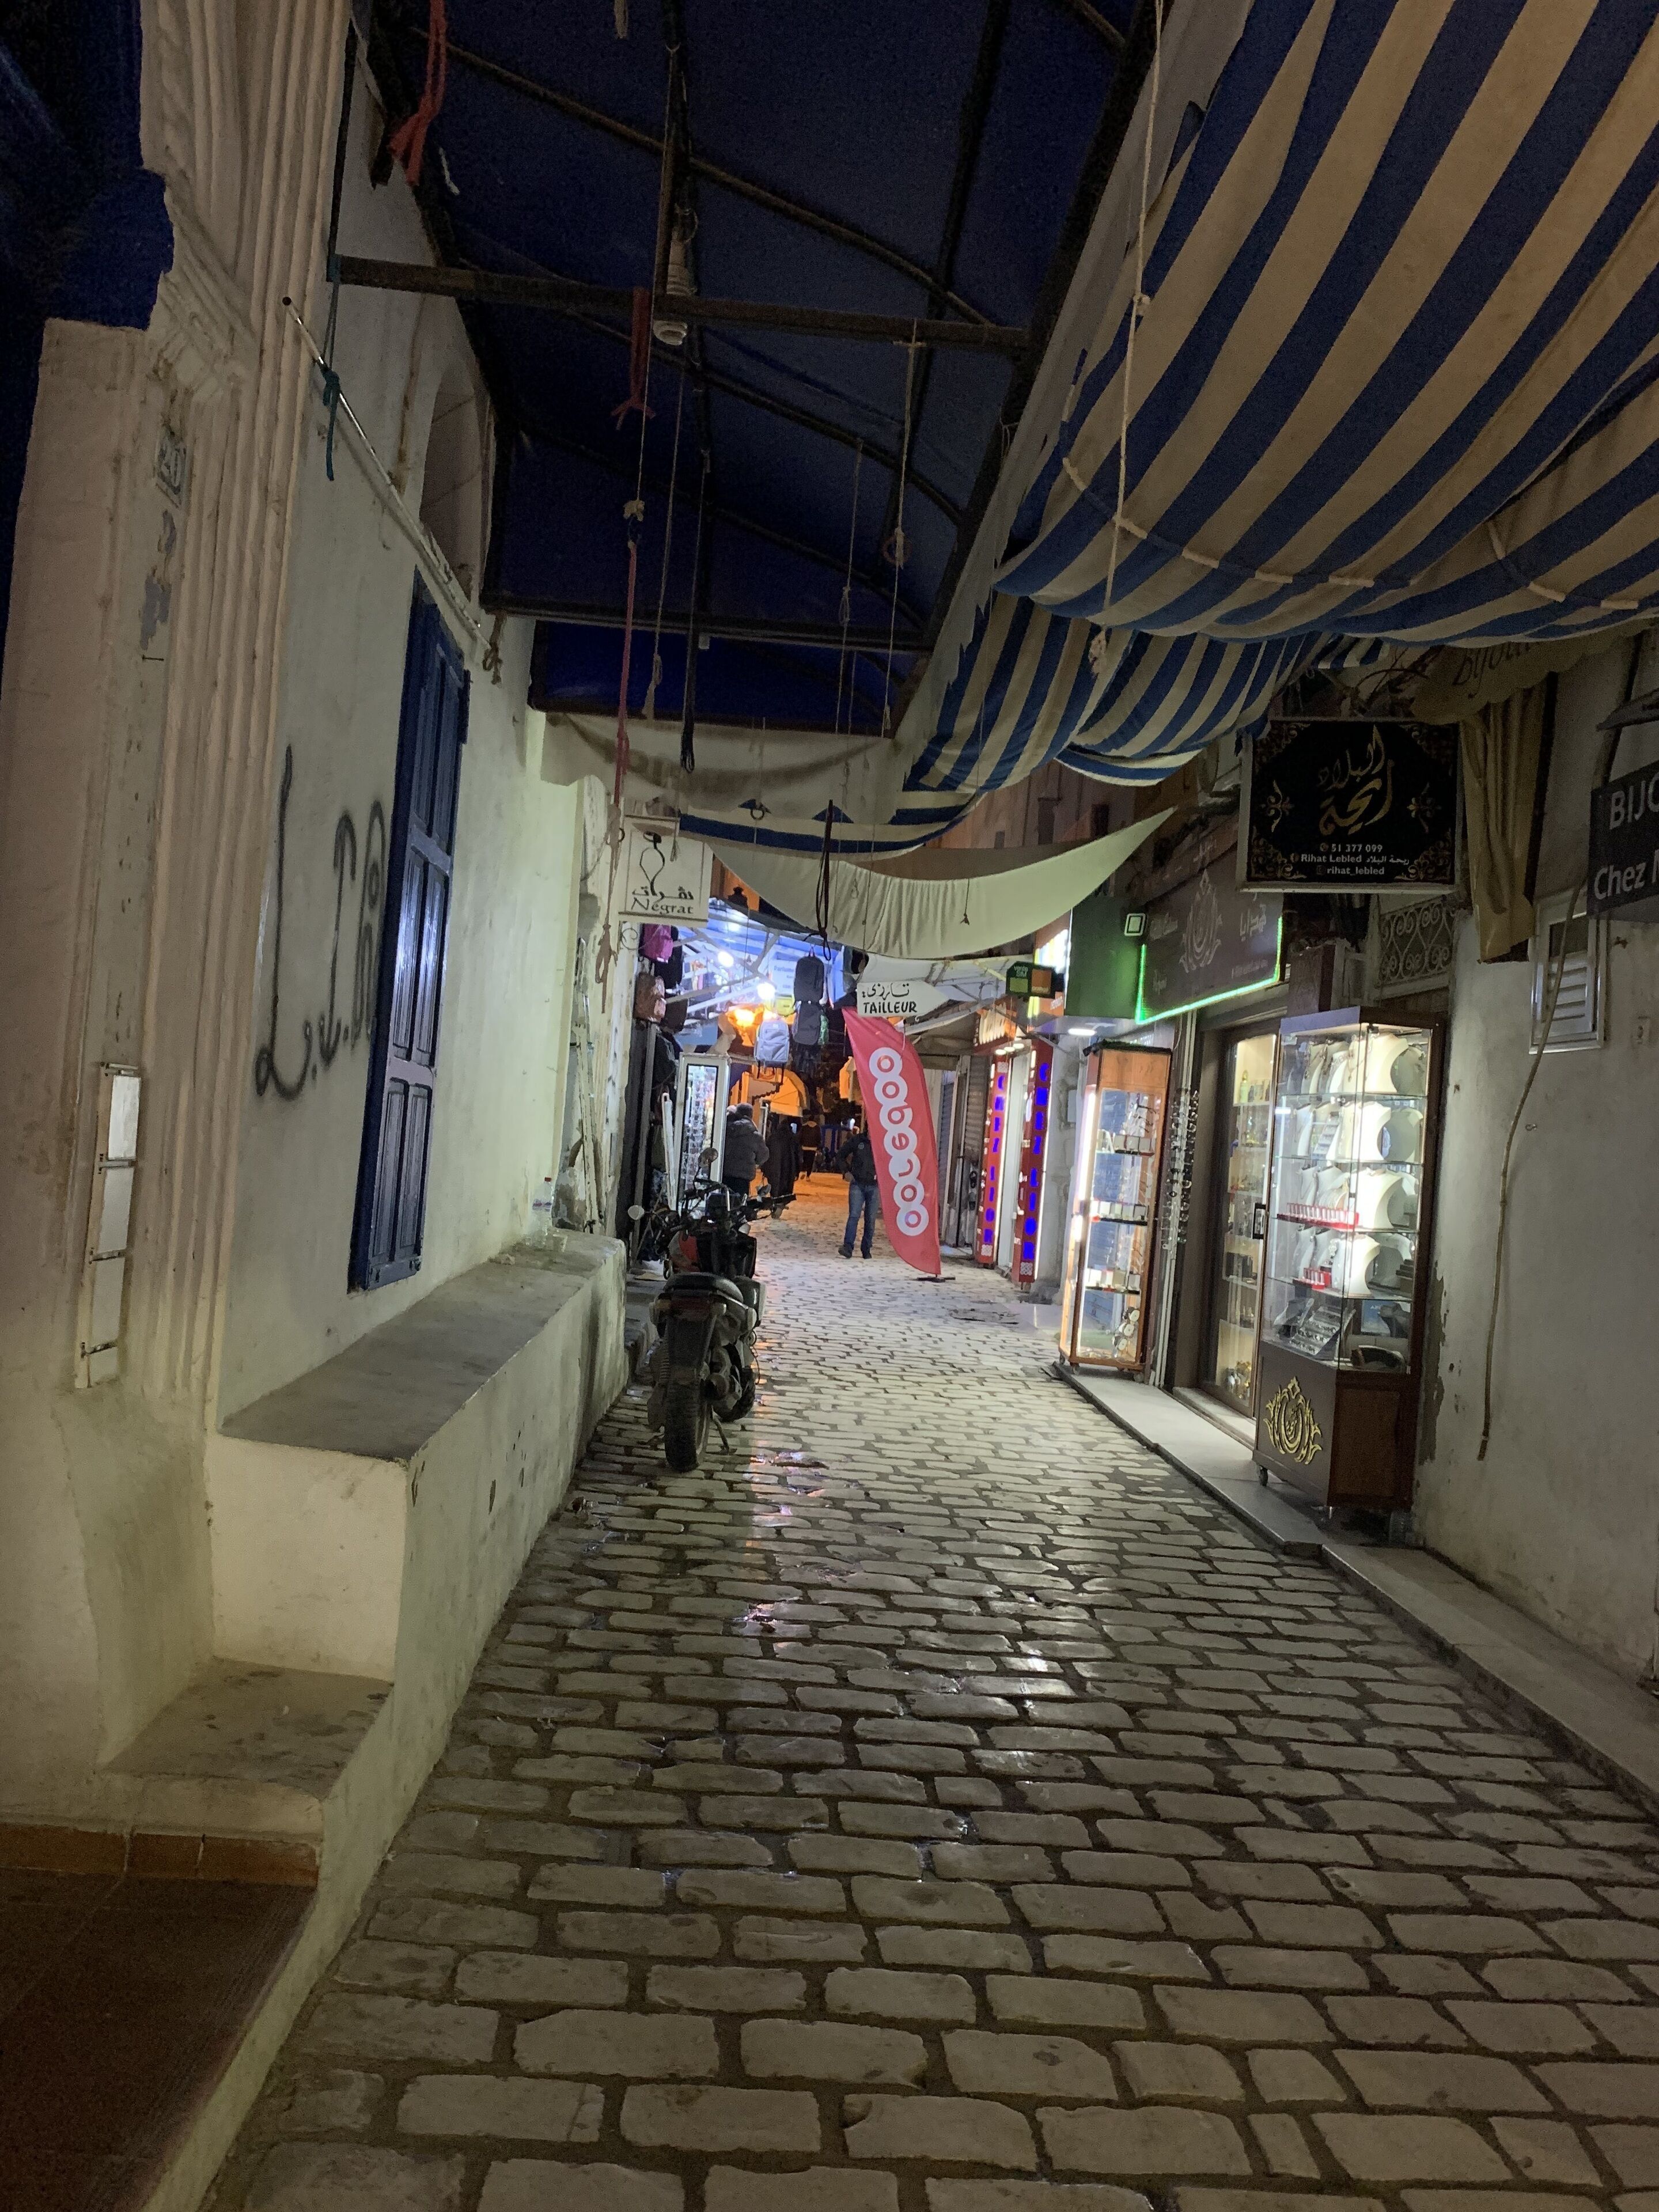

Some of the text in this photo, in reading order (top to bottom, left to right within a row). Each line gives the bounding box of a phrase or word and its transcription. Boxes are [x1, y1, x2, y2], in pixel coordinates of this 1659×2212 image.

[1331, 843, 1383, 853] 51 377 099
[1300, 853, 1362, 863] Rihat Lebled
[1326, 865, 1385, 876] rihat_lebled
[1593, 862, 1647, 900] Chez
[869, 1047, 929, 1237] ooredoo
